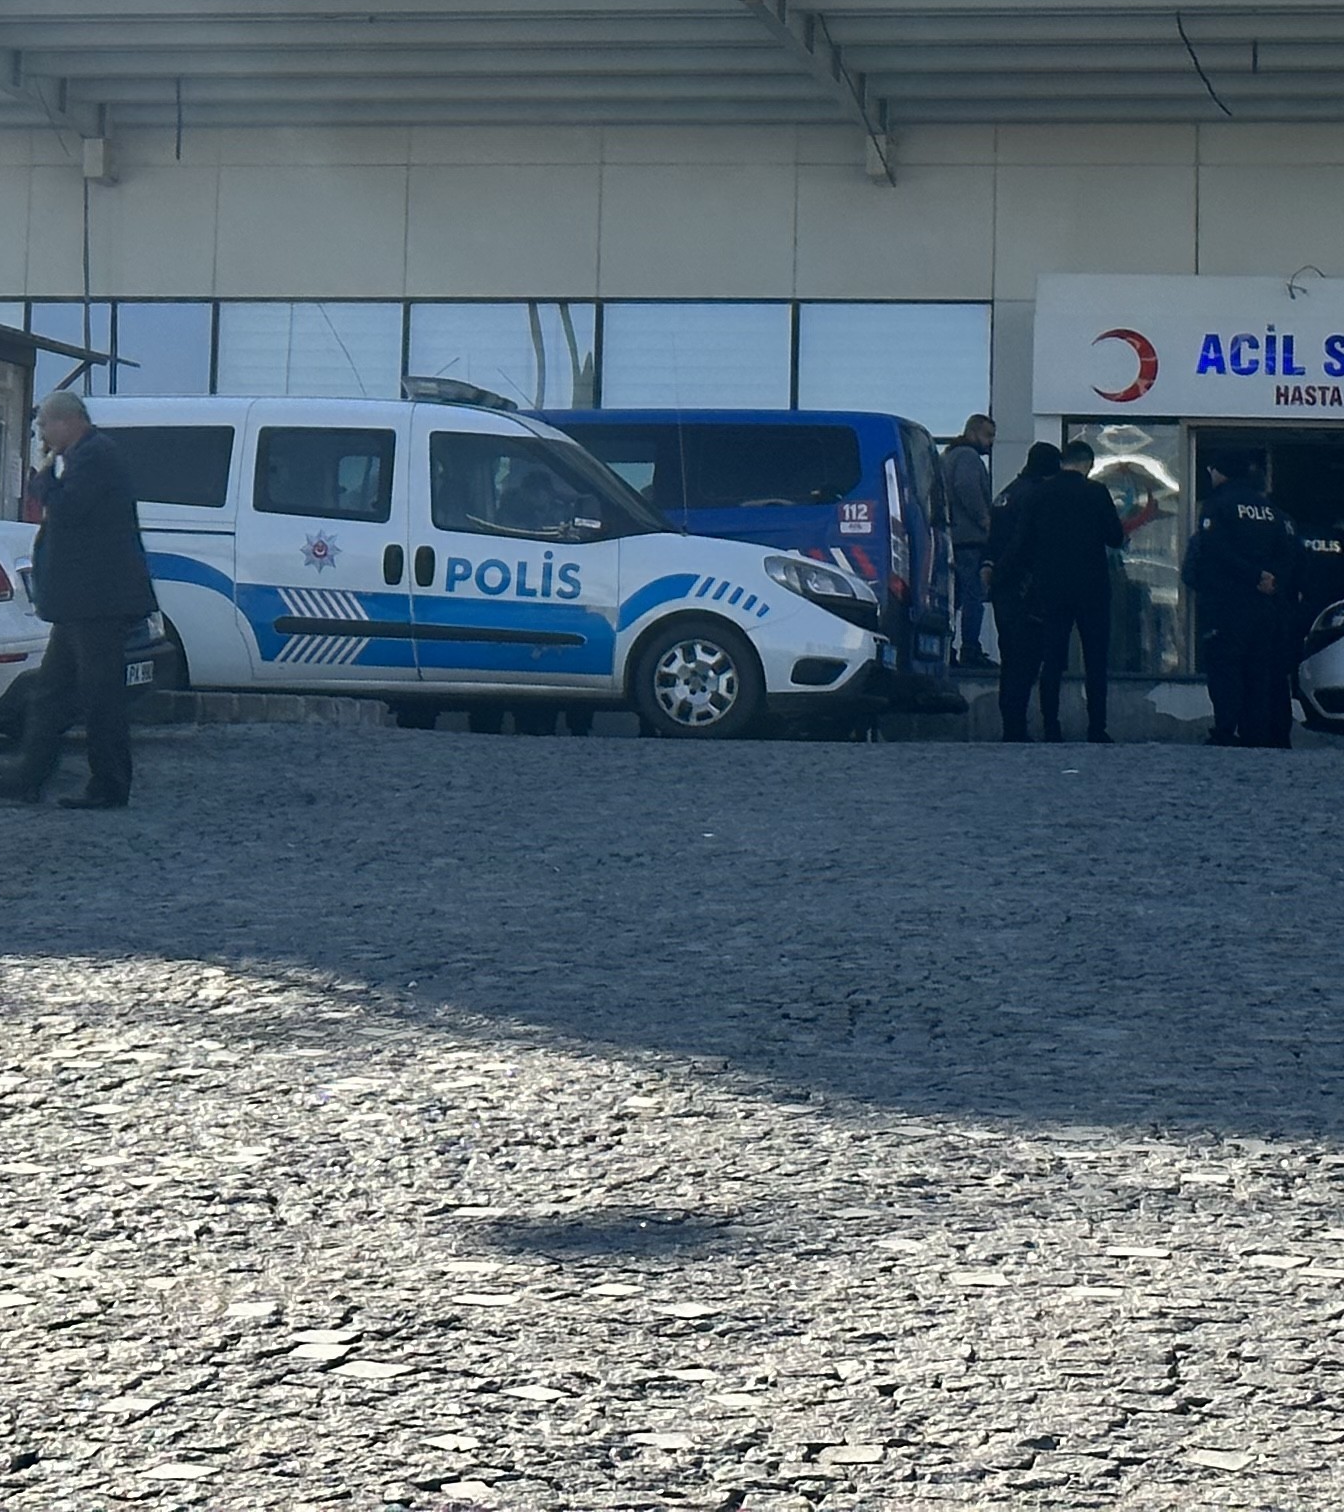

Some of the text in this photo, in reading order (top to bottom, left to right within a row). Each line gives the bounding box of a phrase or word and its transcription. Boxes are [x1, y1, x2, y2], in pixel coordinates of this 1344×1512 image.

[1196, 324, 1306, 376] ACİL
[1275, 384, 1343, 407] HASTA
[843, 503, 868, 521] 112
[445, 550, 581, 599] POLİS
